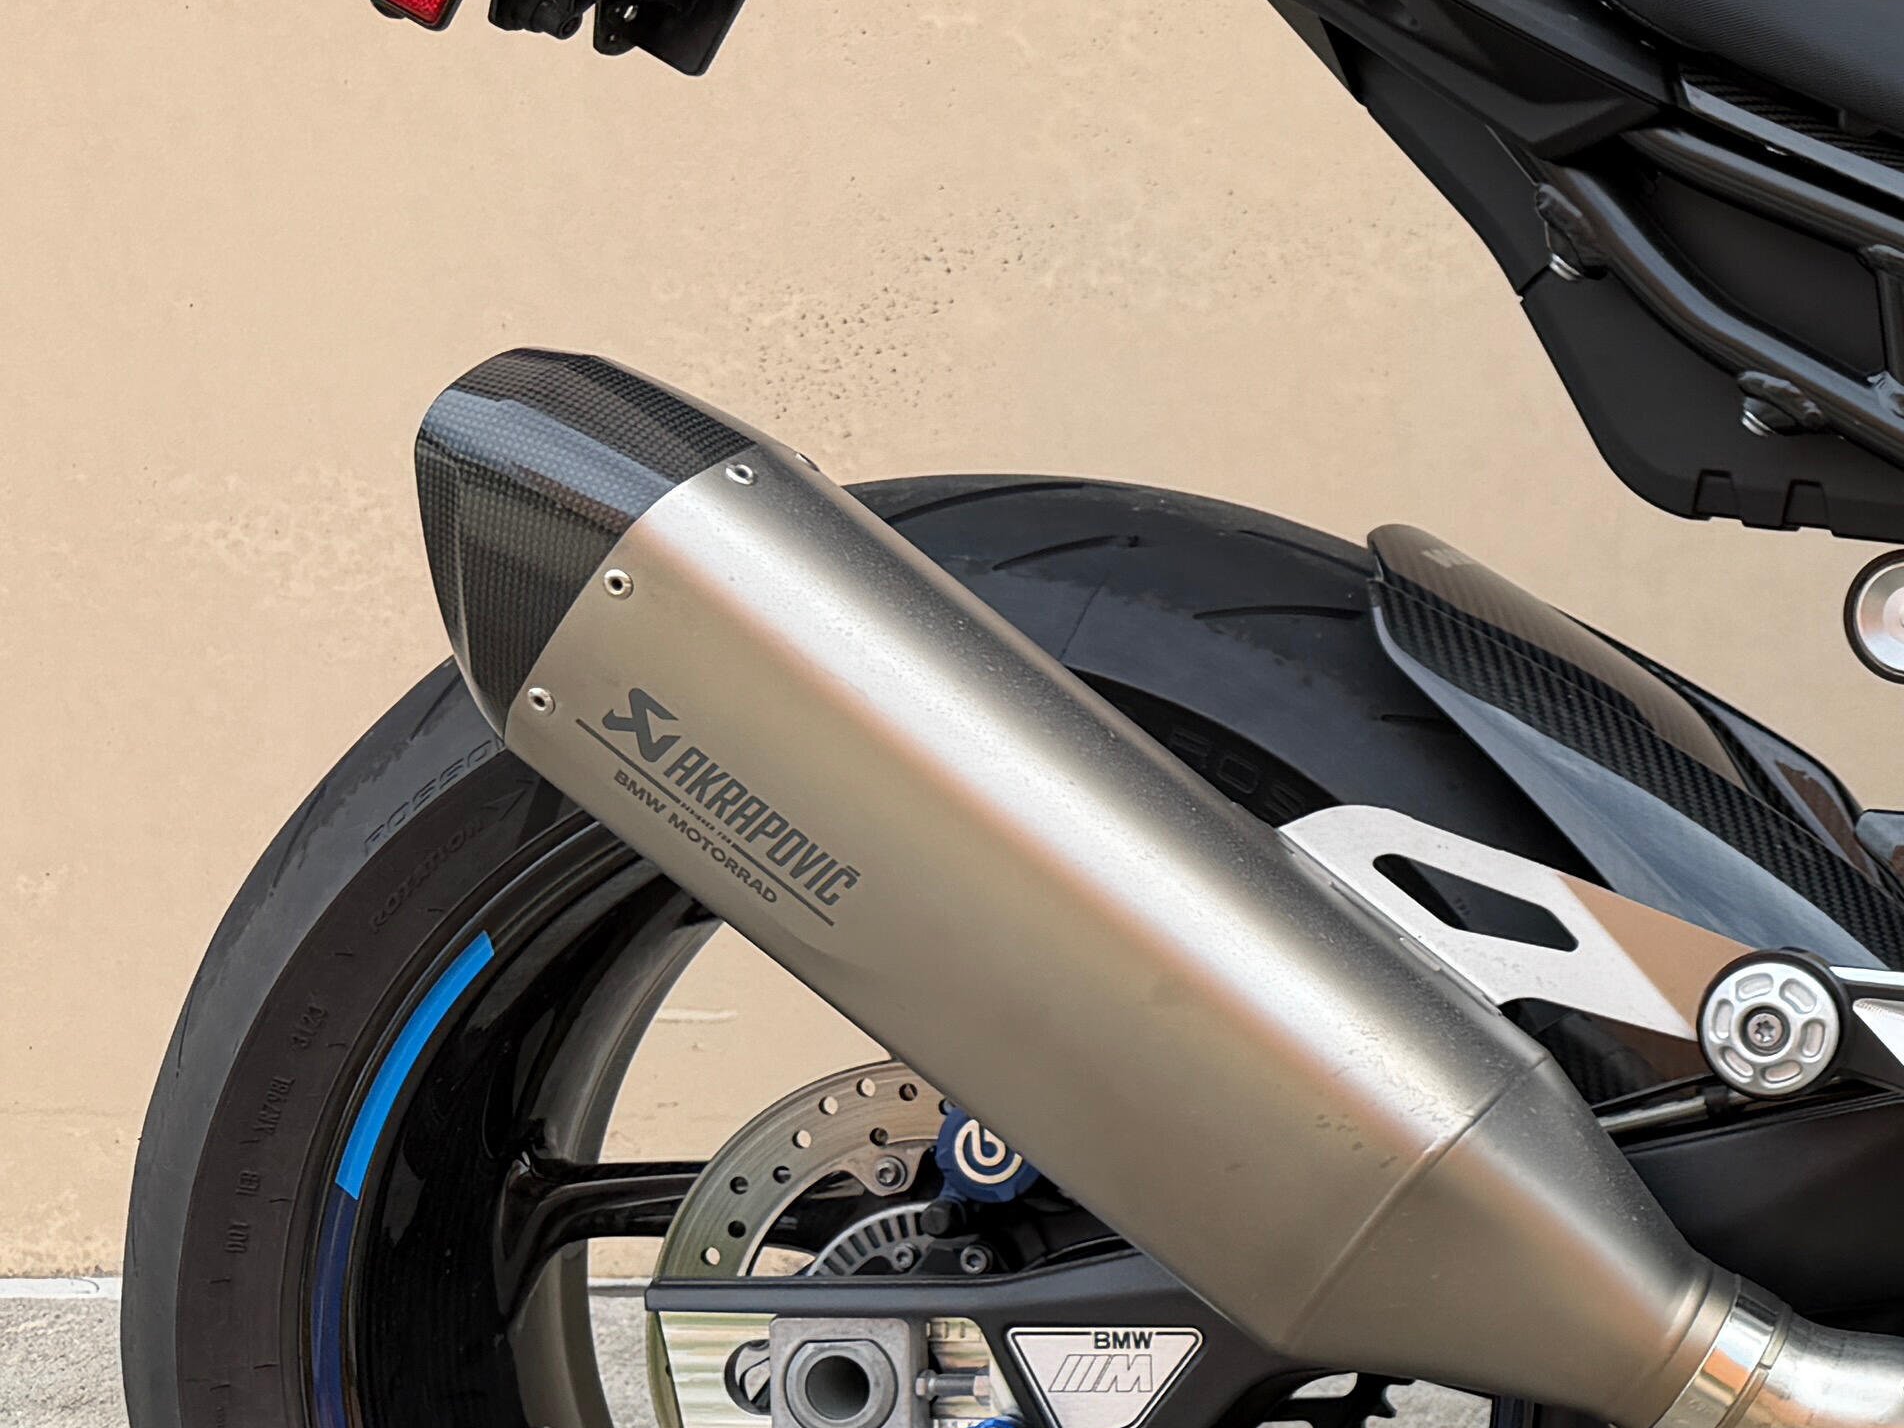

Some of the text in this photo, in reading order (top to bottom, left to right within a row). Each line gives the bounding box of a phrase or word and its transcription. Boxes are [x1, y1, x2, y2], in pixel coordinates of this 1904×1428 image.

[612, 768, 779, 905] BMW MOTORRAD
[1093, 1330, 1154, 1350] BMW
